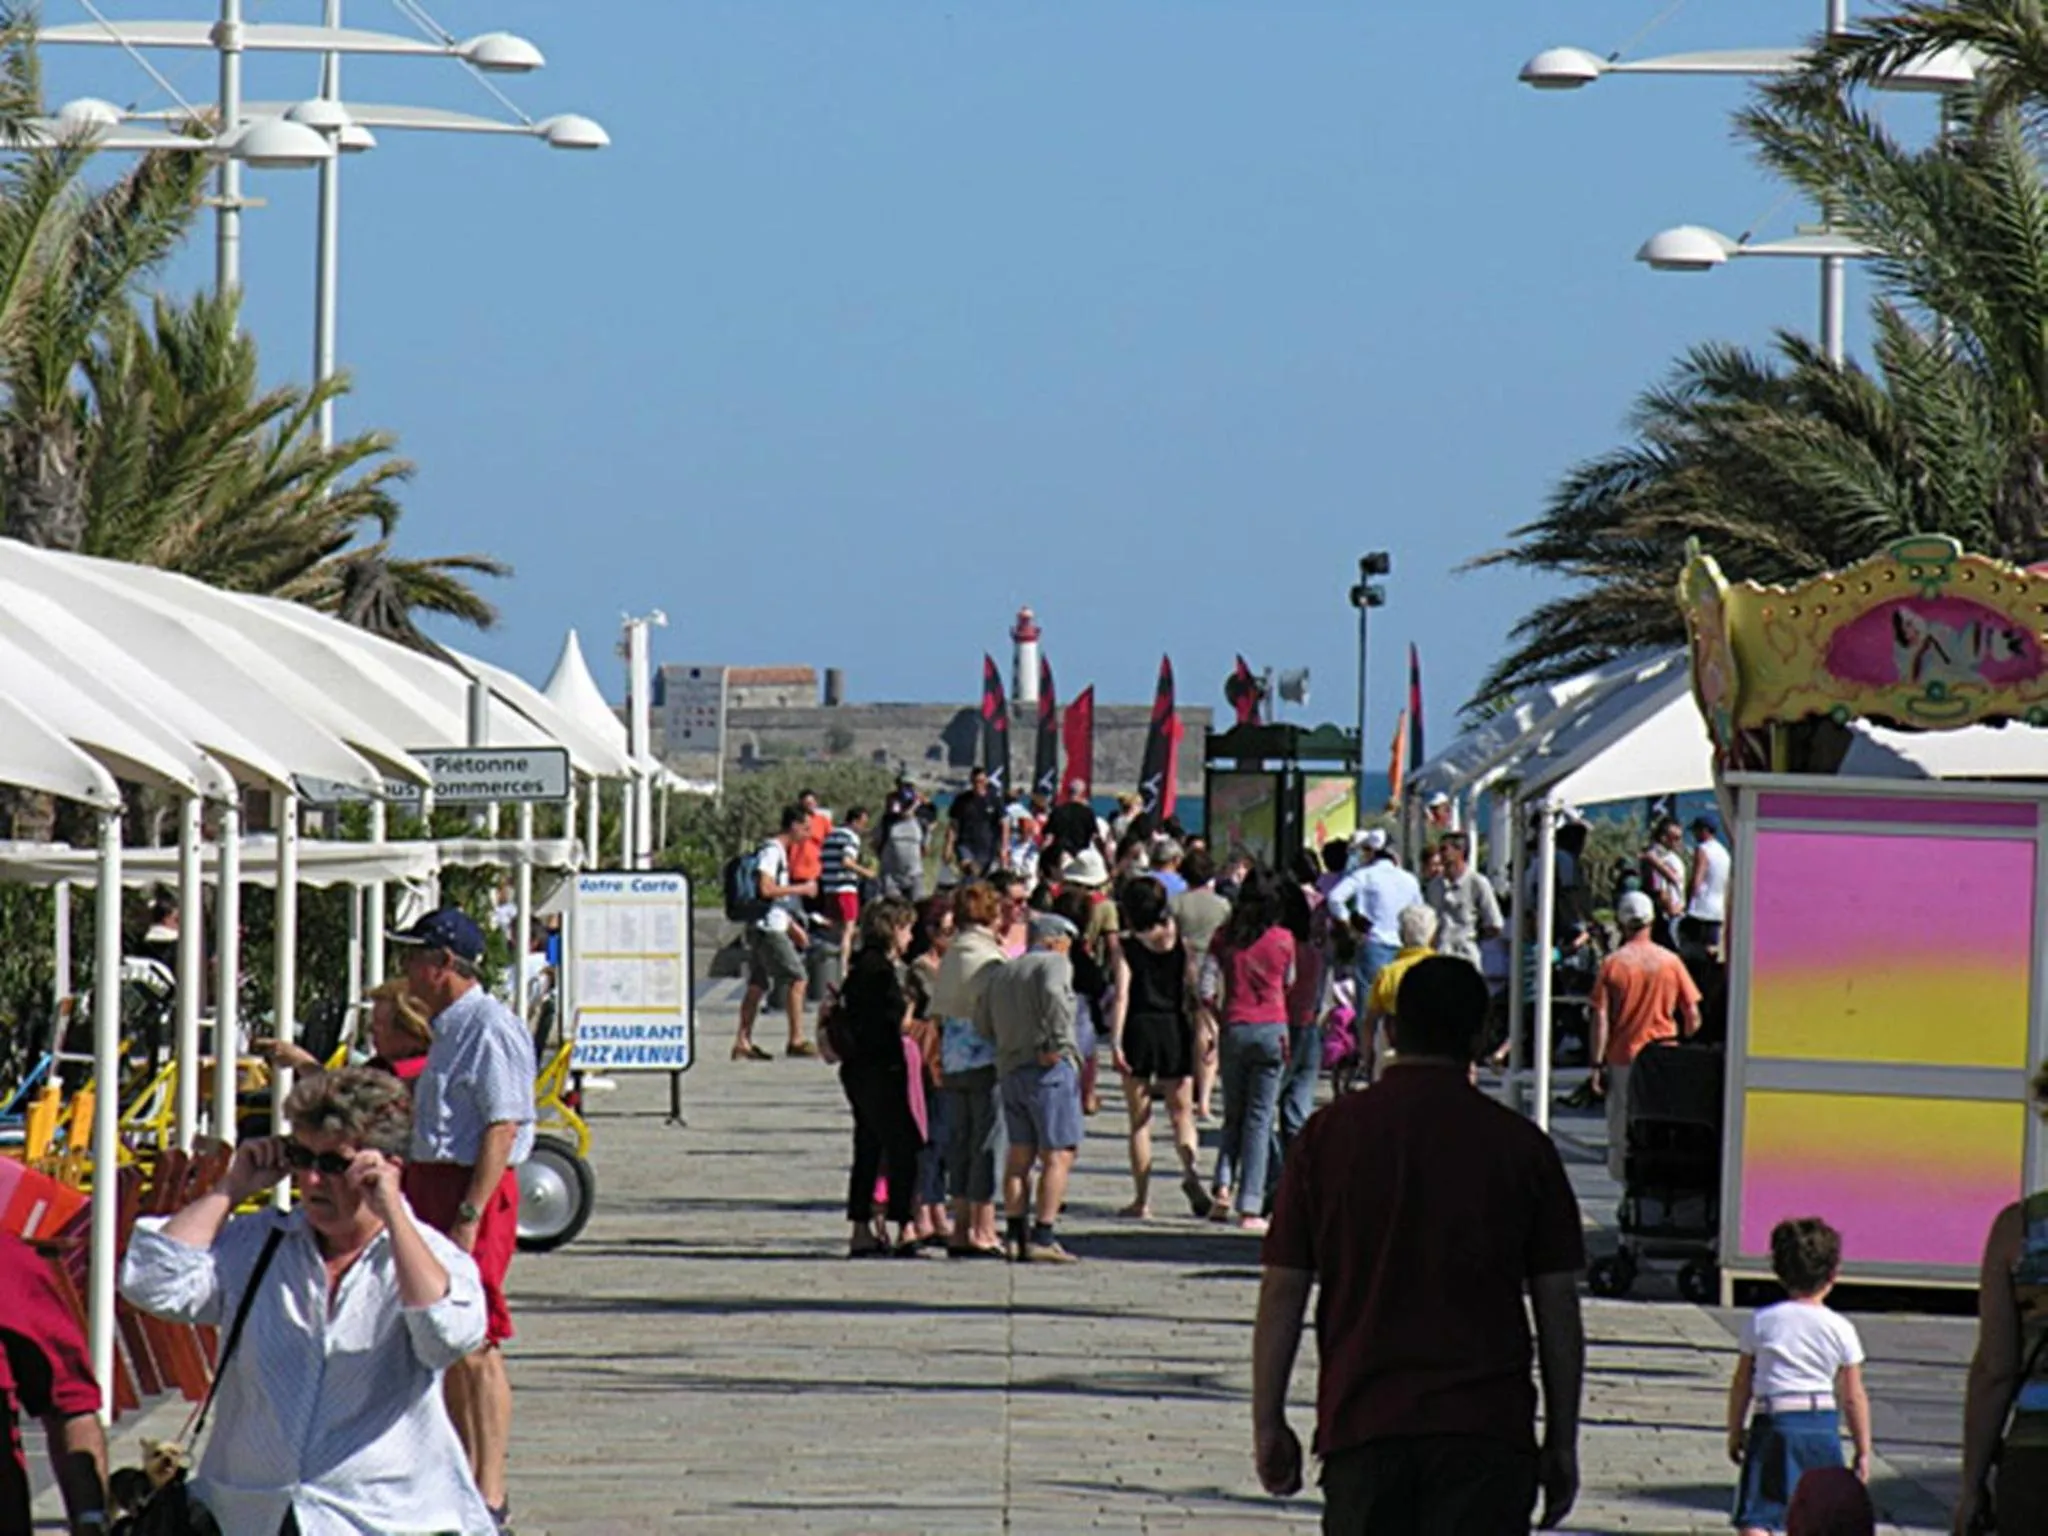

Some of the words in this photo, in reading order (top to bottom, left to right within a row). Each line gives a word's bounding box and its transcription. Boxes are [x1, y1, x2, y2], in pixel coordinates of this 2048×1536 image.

[434, 756, 529, 773] Piétonne
[433, 780, 544, 797] ommerces
[580, 1024, 684, 1039] ESTAURANT
